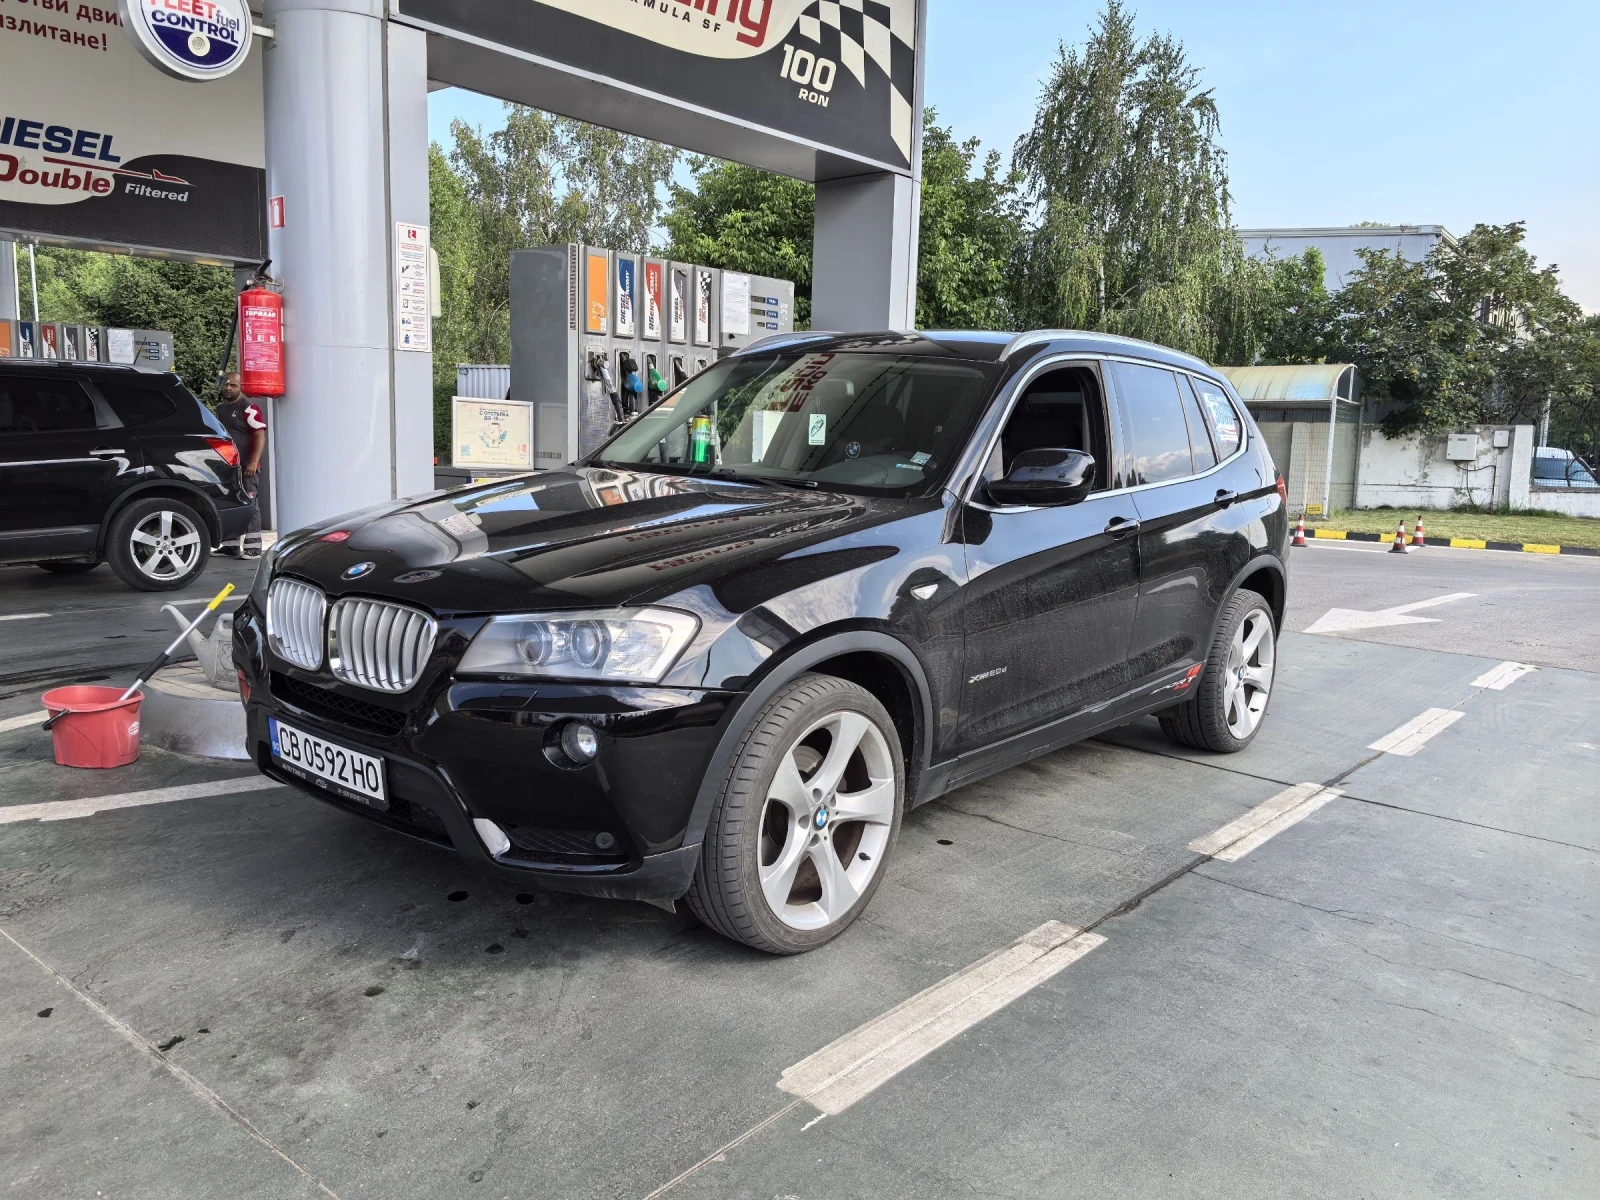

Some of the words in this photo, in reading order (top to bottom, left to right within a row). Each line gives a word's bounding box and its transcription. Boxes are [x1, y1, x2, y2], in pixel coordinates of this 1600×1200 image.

[0, 14, 107, 51] злитане!
[151, 10, 239, 44] CONTROL
[216, 10, 239, 31] fuel
[702, 19, 721, 32] SF
[780, 43, 837, 93] 100
[798, 88, 830, 108] RON
[0, 116, 121, 163] IESEL
[125, 182, 189, 202] Filtered
